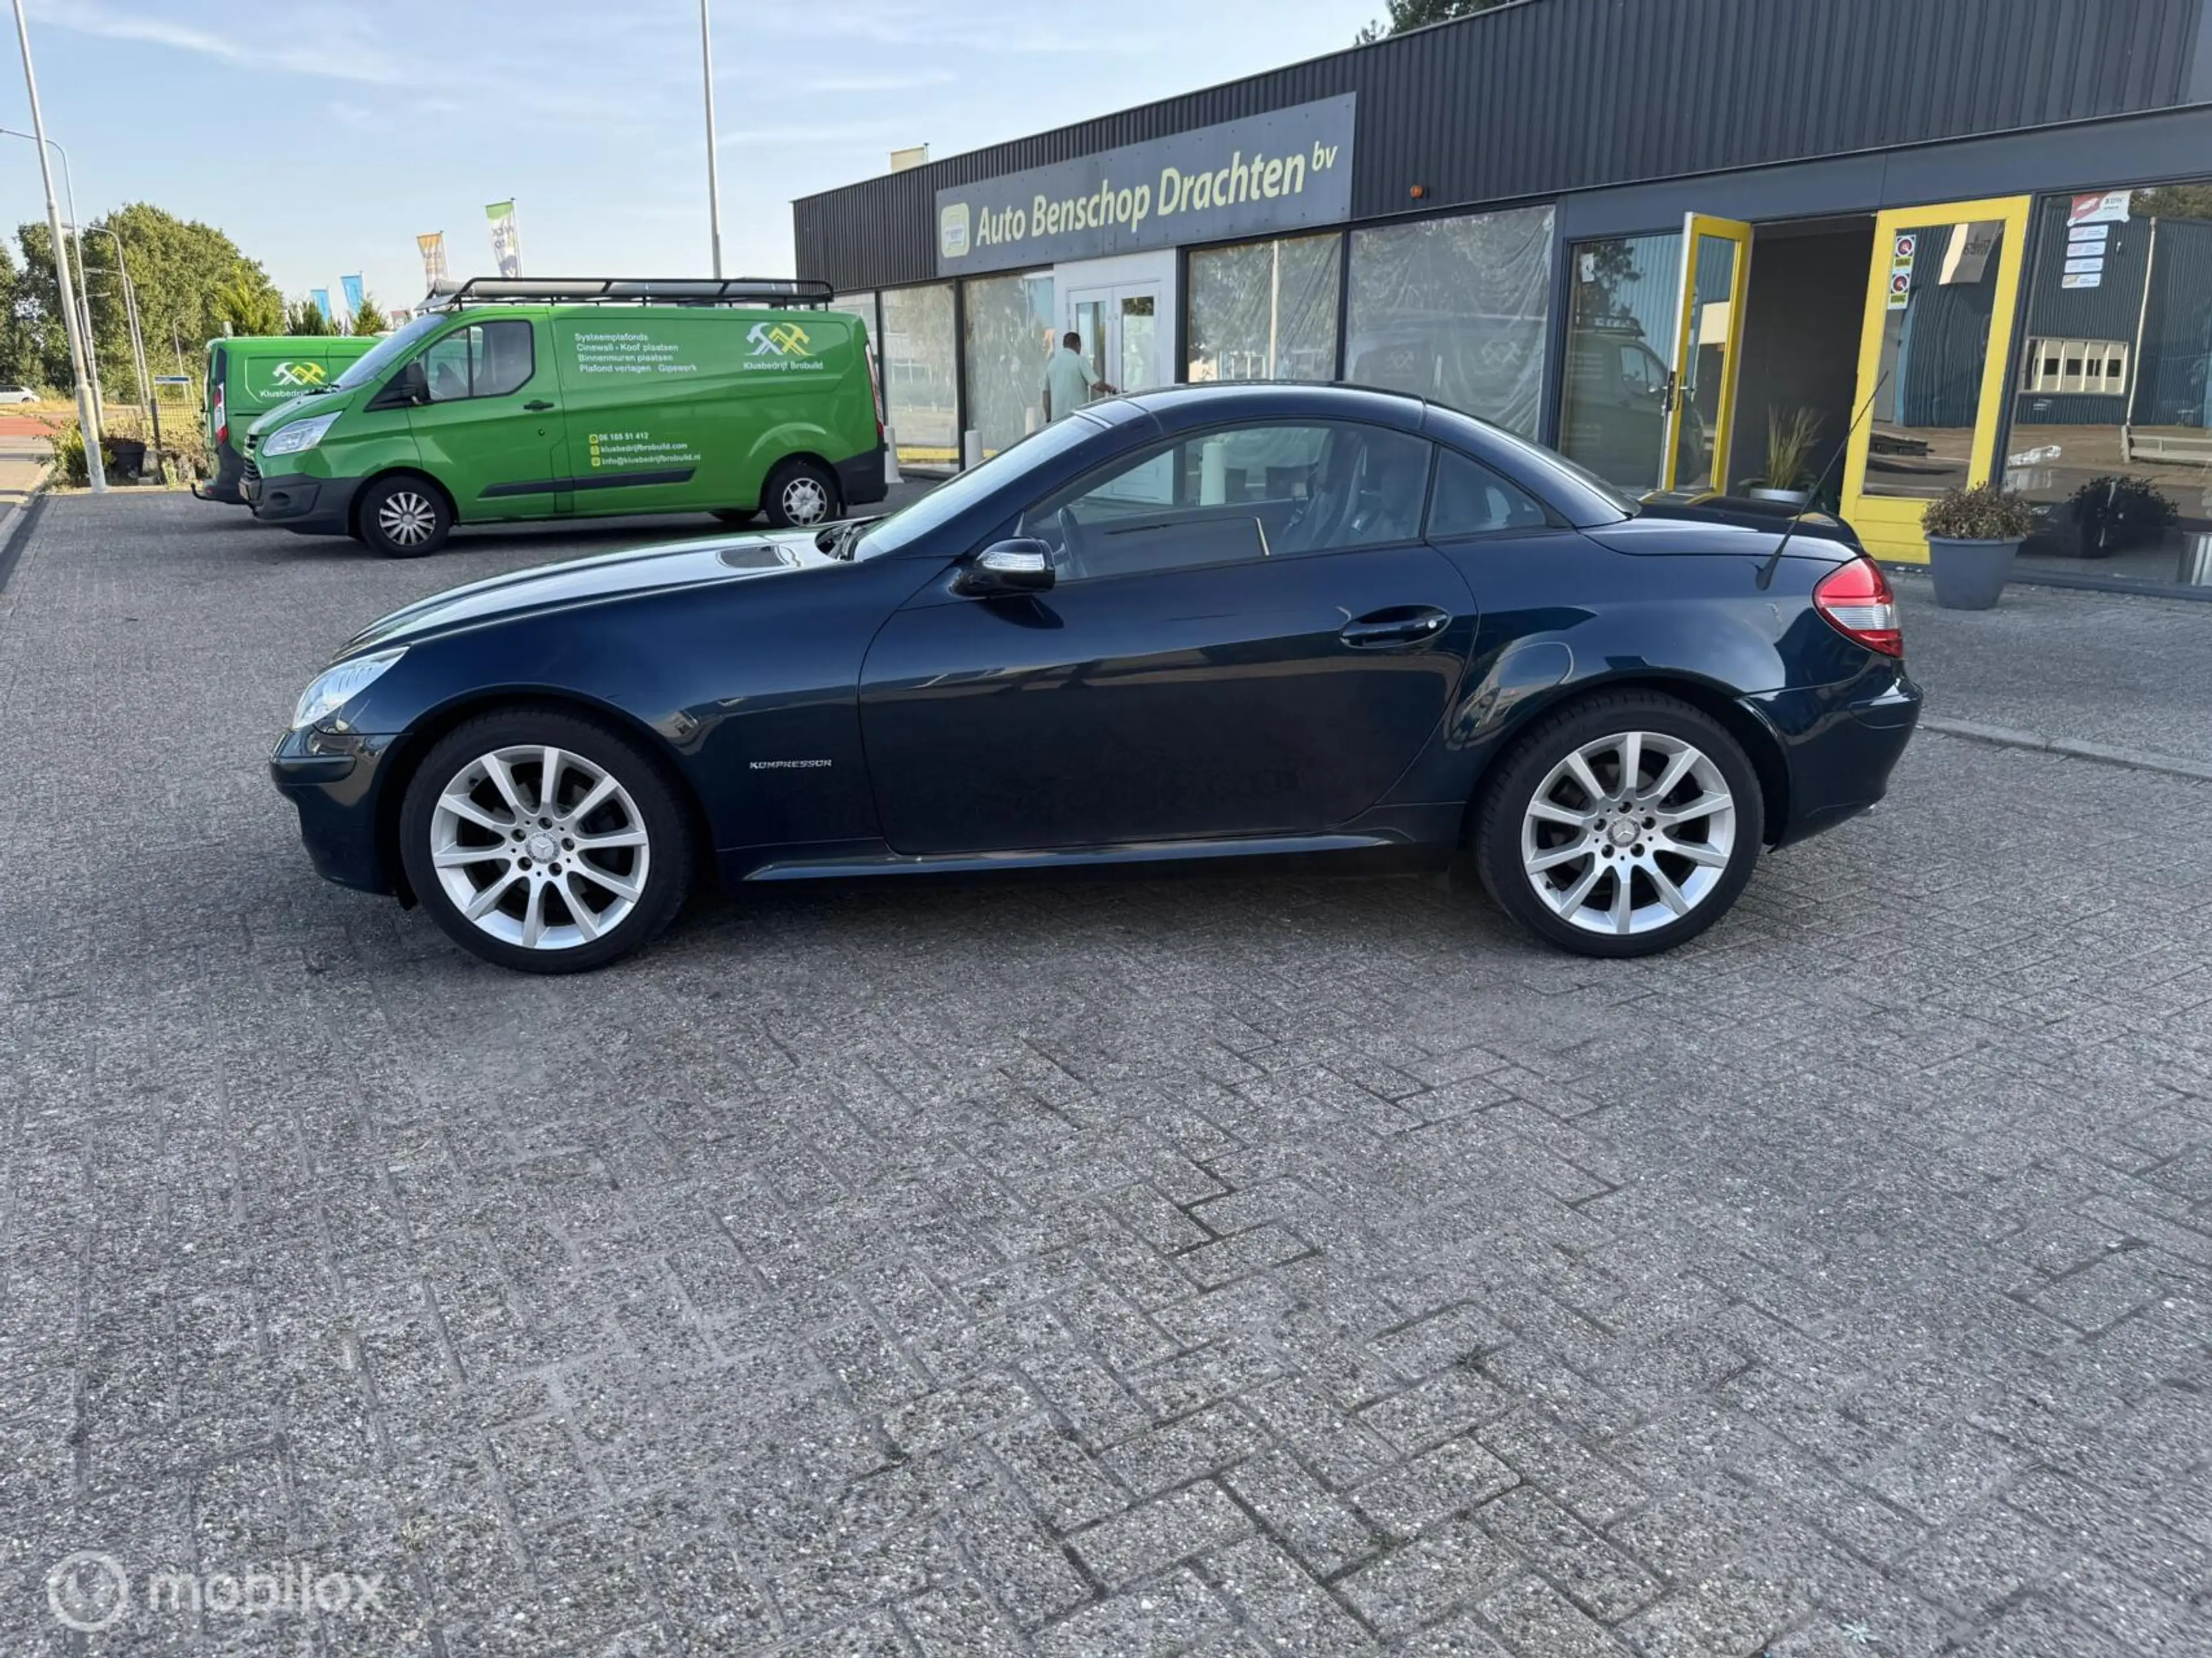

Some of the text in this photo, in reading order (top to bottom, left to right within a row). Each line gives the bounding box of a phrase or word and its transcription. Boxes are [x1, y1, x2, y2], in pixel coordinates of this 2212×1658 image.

[976, 141, 1338, 246] Auto Benschop Drachten bv
[575, 332, 649, 342] Systeemplafonds
[577, 343, 614, 351] Cinewall
[620, 343, 640, 351] Koof
[643, 344, 679, 352] plaatsen
[578, 354, 674, 363] Binnenmuren plaatsen
[579, 364, 613, 372] Plafond
[615, 365, 652, 374] verlagen
[743, 360, 824, 371] Klusbedrijf Brobuild
[749, 760, 832, 769] KOMPRESSOR
